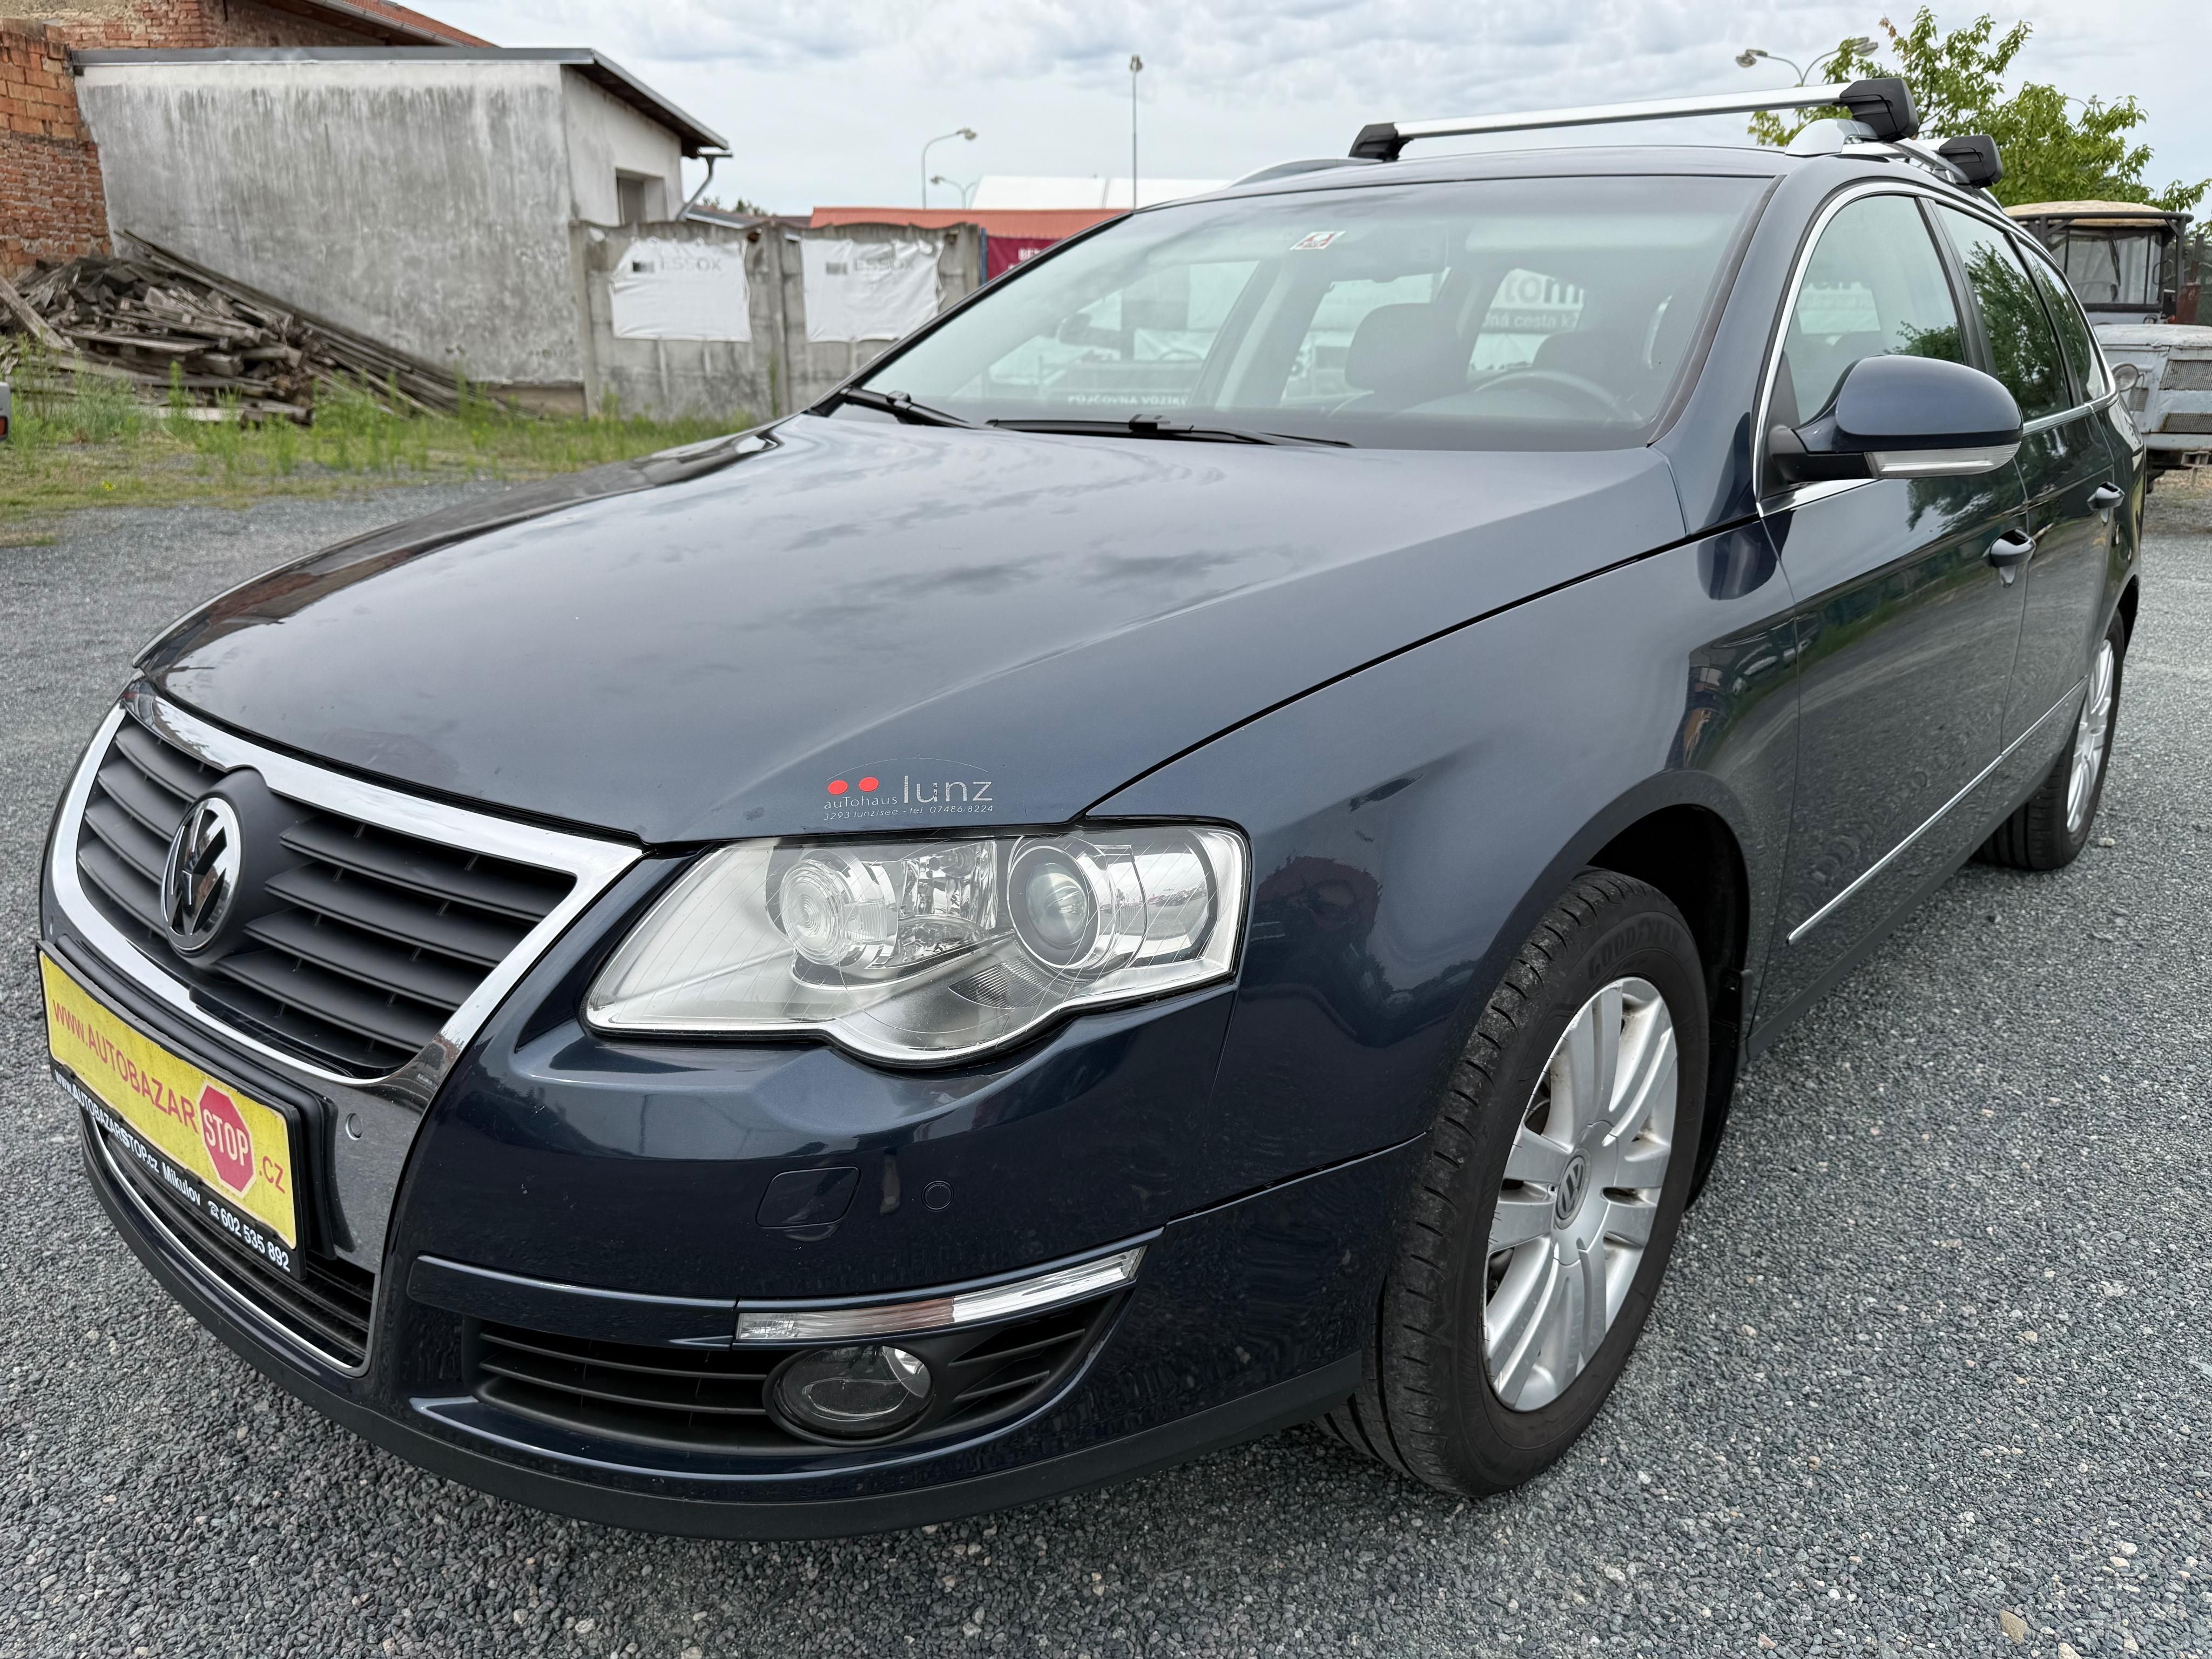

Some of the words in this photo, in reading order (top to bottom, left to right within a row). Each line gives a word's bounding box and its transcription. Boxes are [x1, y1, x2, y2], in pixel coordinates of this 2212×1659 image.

[903, 775, 993, 804] lunz
[823, 811, 850, 820] 3293
[854, 810, 899, 818] lunz/see
[203, 1108, 249, 1166] STOP
[161, 1162, 201, 1206] Mikulov
[220, 1207, 242, 1238] 602
[243, 1224, 266, 1254] 535
[267, 1241, 291, 1272] 892
